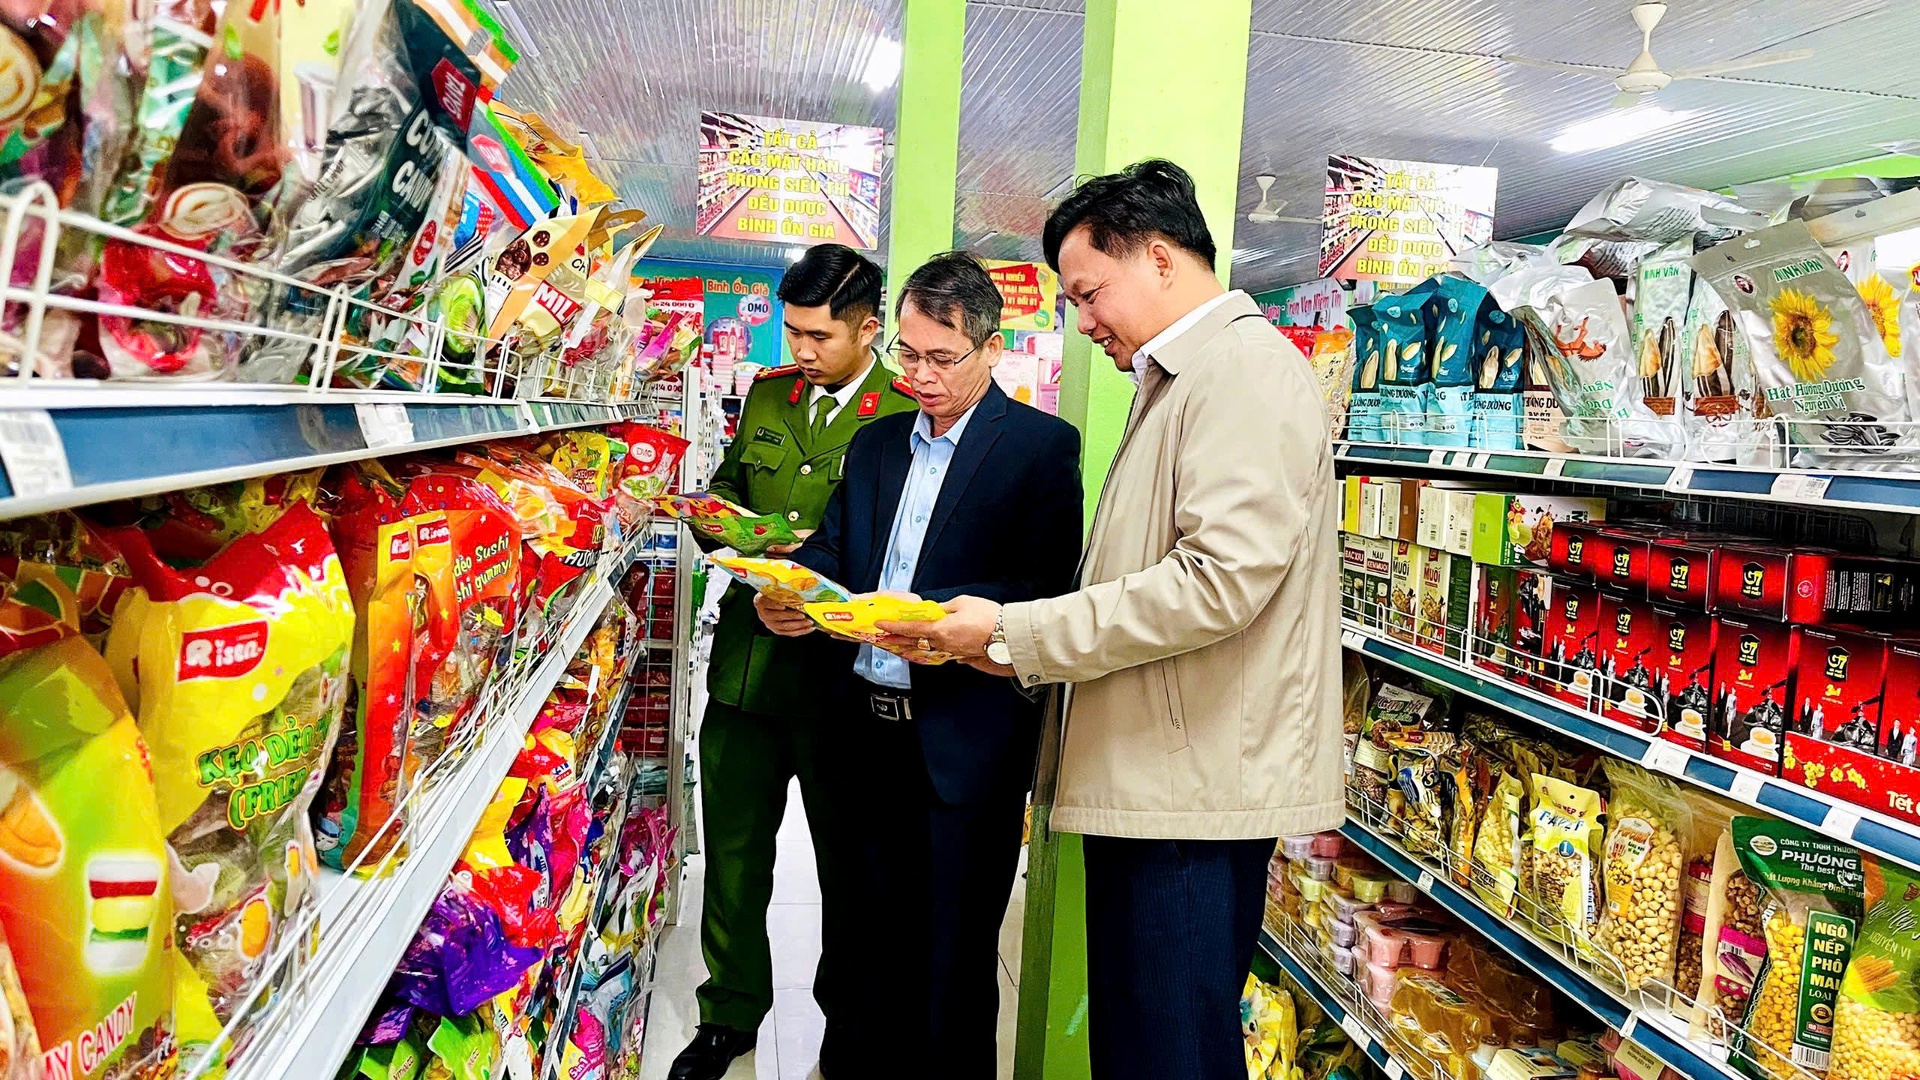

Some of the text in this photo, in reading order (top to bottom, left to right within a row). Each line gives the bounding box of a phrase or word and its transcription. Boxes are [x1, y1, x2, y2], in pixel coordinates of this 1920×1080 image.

[764, 127, 818, 150] TẤT CẢ
[728, 147, 762, 166] CÁC
[766, 152, 801, 171] MẶT
[726, 172, 780, 190] TRONG
[785, 177, 821, 194] SIÊU
[1386, 170, 1412, 190] TẤT
[1352, 190, 1383, 209] CÁC
[737, 214, 777, 234] BÌNH
[808, 221, 836, 239] GIÁ
[1349, 214, 1399, 232] TRONG
[1404, 218, 1438, 235] SIÊU
[1356, 256, 1394, 275] BÌNH
[533, 282, 577, 322] MIL
[747, 302, 769, 313] OMO
[1767, 384, 1791, 402] Hạt
[475, 530, 510, 562] Sushi
[1886, 789, 1914, 814] Tết
[1780, 837, 1800, 847] CÔNG
[1781, 849, 1857, 870] PHƯƠNG
[1800, 863, 1814, 872] The
[1817, 866, 1835, 876] best
[1815, 920, 1848, 939] NGÔ
[1813, 937, 1845, 956] NẾP
[1811, 956, 1843, 974] PHÔ
[79, 991, 138, 1075] CANDY
